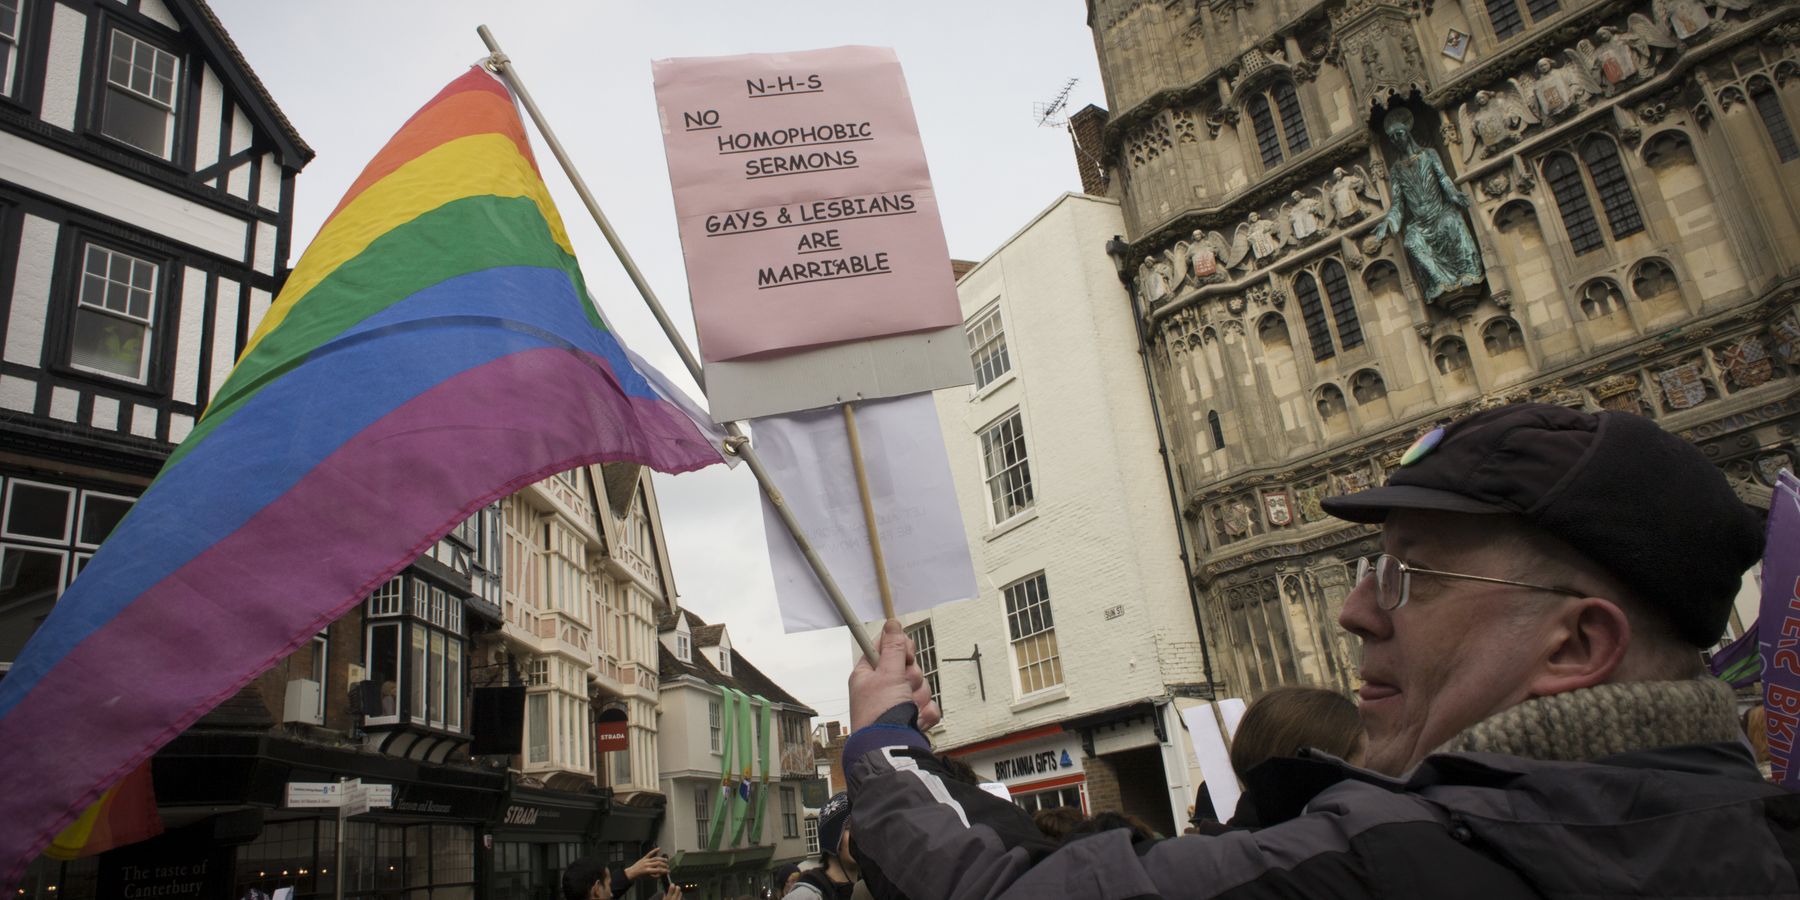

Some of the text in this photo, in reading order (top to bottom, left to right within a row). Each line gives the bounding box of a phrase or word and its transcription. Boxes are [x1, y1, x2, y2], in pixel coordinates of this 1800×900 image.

[746, 74, 823, 95] N-H-S
[683, 109, 720, 128] NO
[717, 121, 872, 151] HOMOPHOBIC
[745, 150, 858, 176] SERMONS
[705, 194, 915, 234] GAYS & LESBIANS
[797, 229, 841, 251] ARE
[600, 733, 625, 741] STRADA
[995, 750, 1057, 781] BRITANNIA GIFTS
[504, 805, 540, 825] STRADA
[121, 859, 209, 880] The taste of
[124, 880, 203, 898] Canterbury
